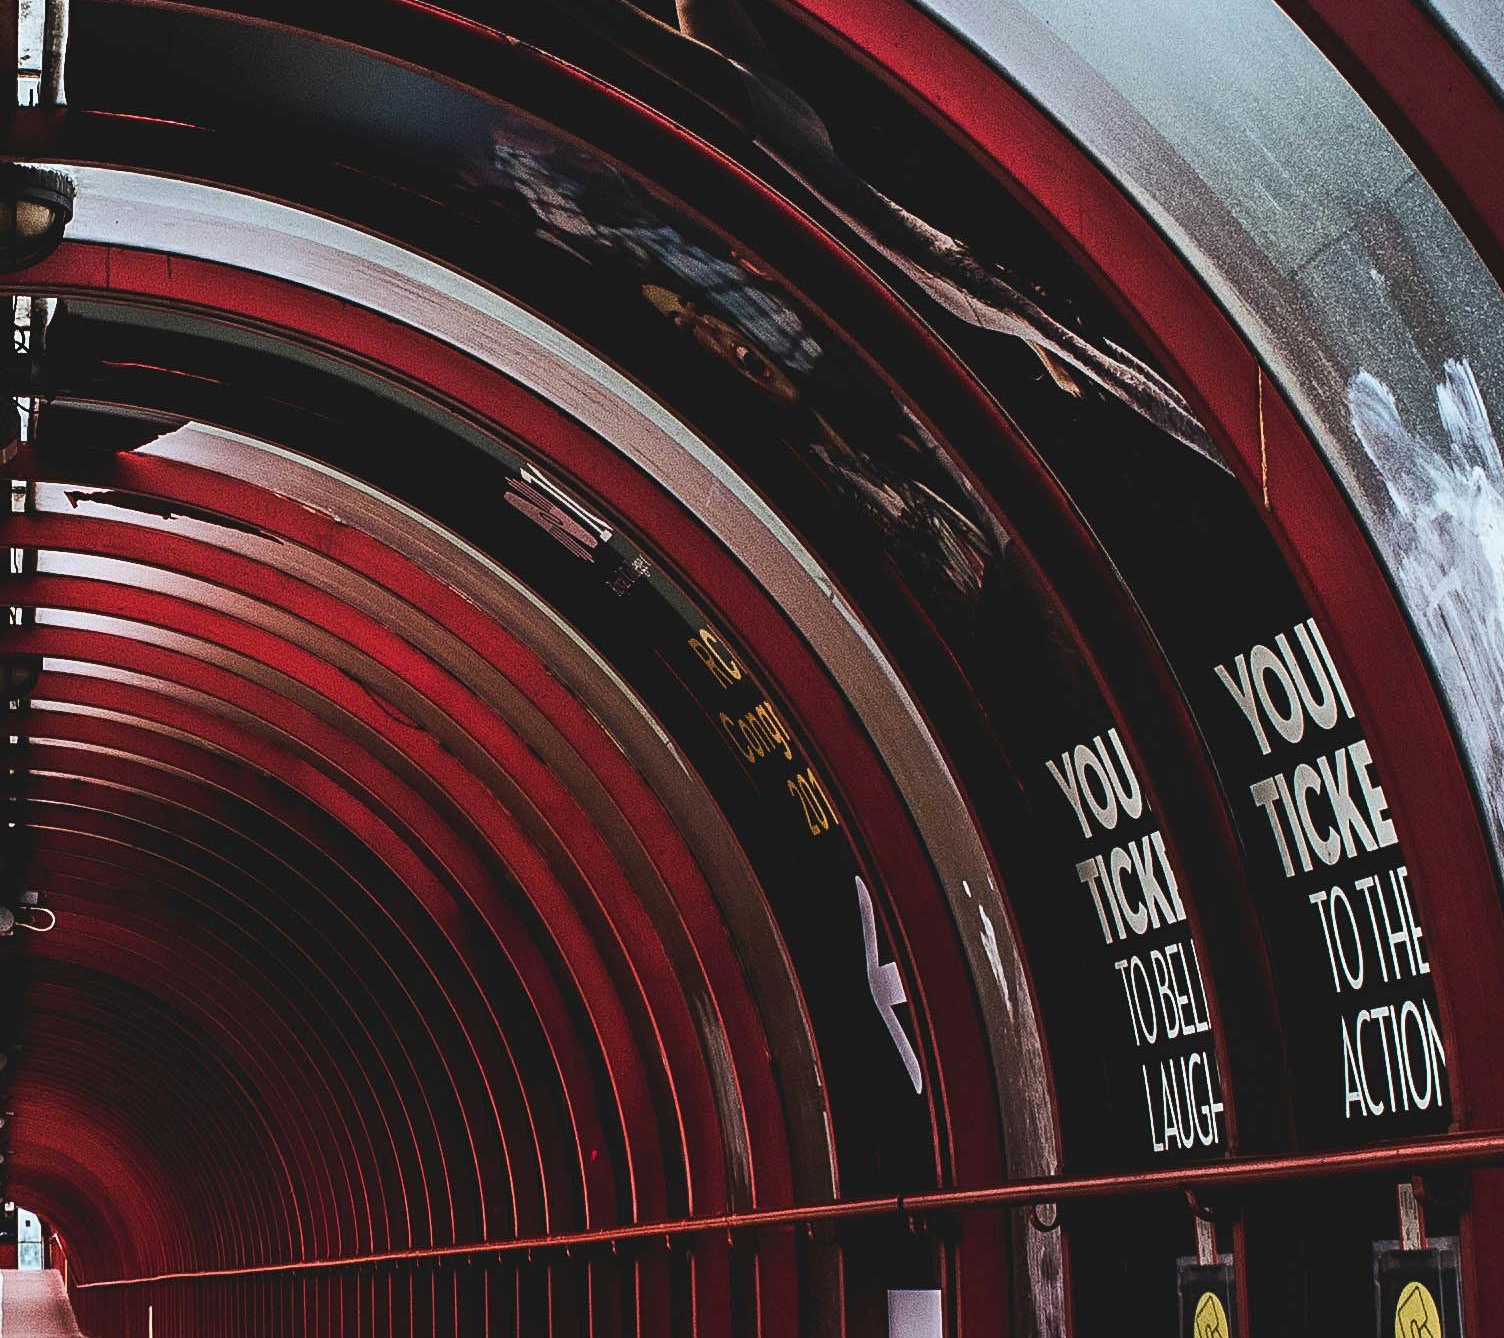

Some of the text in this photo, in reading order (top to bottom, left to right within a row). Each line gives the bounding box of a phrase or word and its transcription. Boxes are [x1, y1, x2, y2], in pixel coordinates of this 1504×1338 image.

[1250, 739, 1399, 878] TICKE
[1309, 866, 1430, 993] TO THE
[1115, 956, 1157, 1046] TO
[1341, 999, 1446, 1118] ACTION
